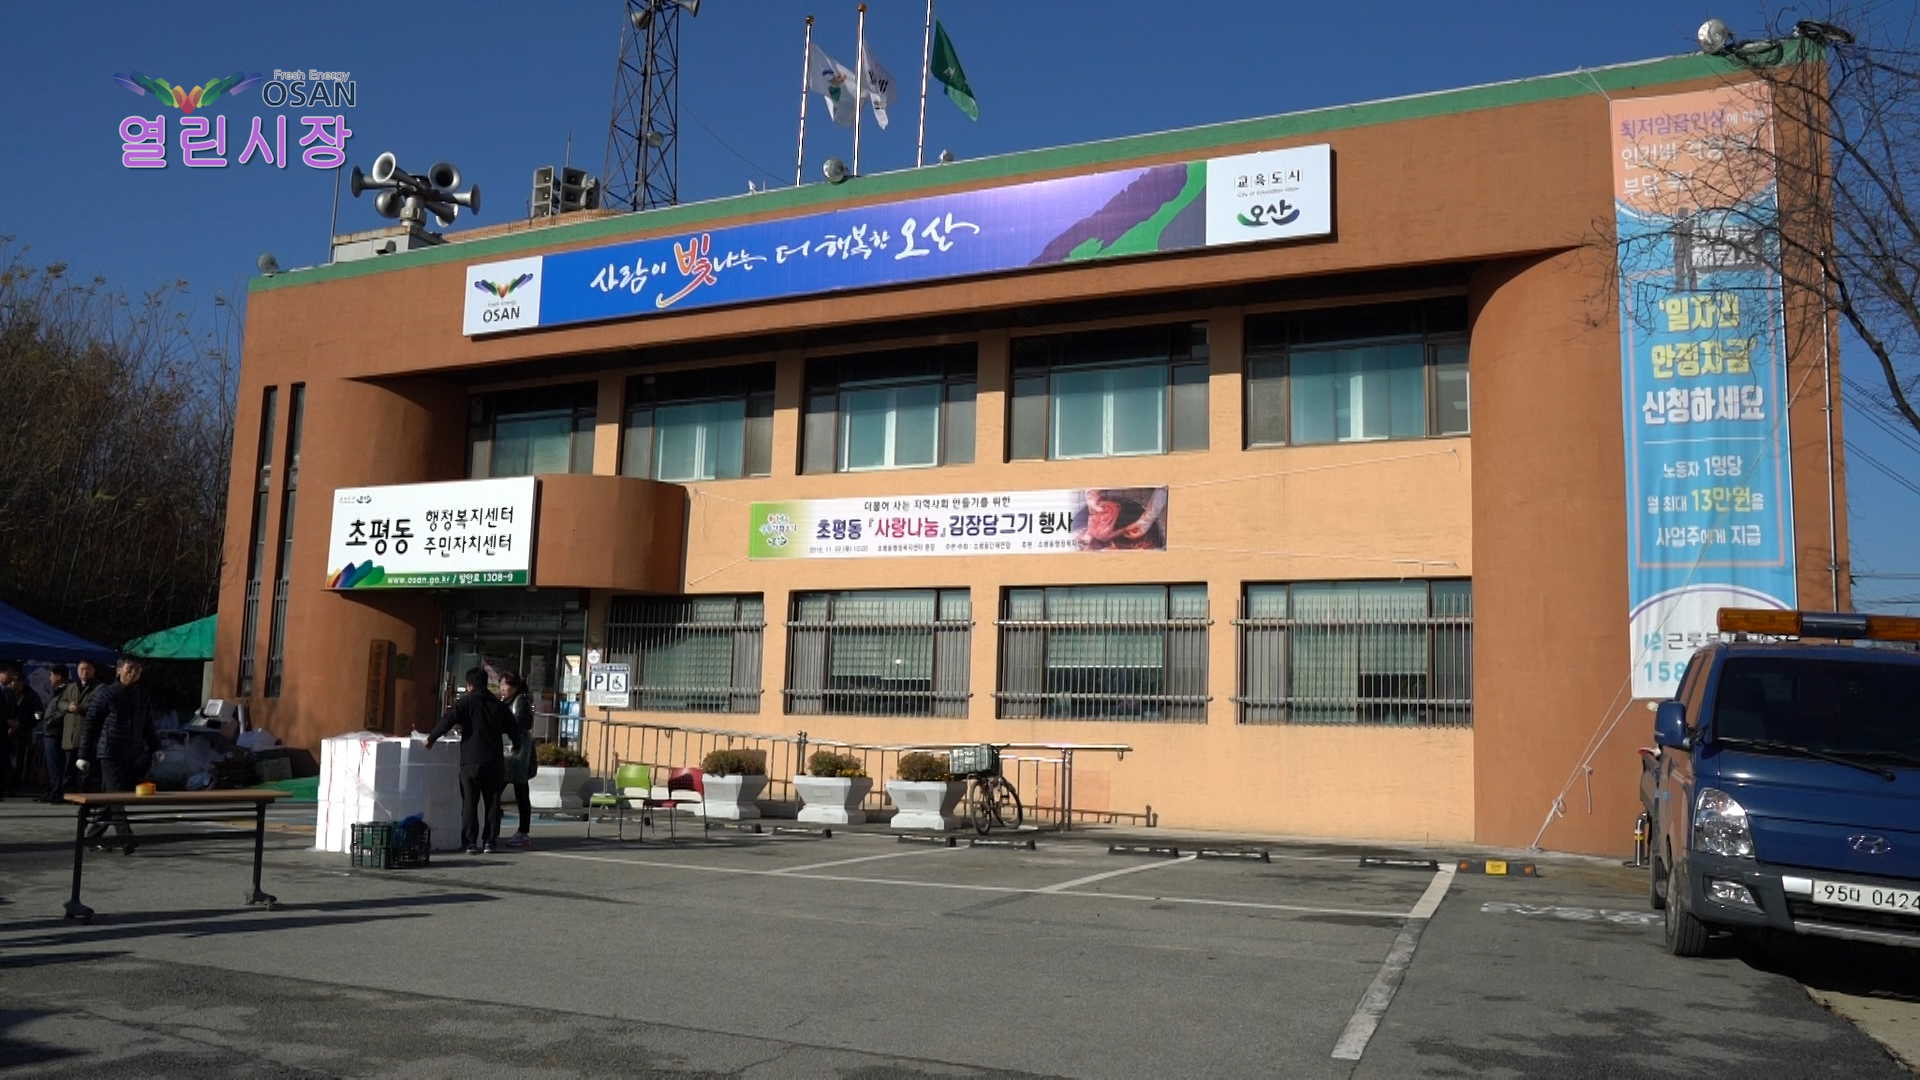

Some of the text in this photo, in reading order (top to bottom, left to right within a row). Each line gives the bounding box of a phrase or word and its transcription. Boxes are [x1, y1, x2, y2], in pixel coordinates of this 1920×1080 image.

[1237, 170, 1300, 188] 교육도시
[1237, 199, 1300, 227] 오산
[590, 212, 981, 309] 사람이 빛나는 더 행복한 오산
[482, 305, 520, 324] OSAN
[1642, 385, 1766, 425] 신청하세요
[1663, 455, 1743, 479] 노동자 1명당
[864, 495, 1011, 512] 더불어 사는 지역사회 만들기를 위한
[1647, 495, 1660, 514] 월
[1662, 495, 1687, 513] 최대
[345, 505, 514, 556] 초평동 행정복지센터
[816, 518, 863, 541] 초평동
[949, 512, 1034, 537] 김장담그기
[1038, 511, 1074, 534] 행사
[1656, 524, 1762, 548] 사업주에게 지급
[423, 533, 512, 558] 주민자치센터
[387, 575, 450, 586] www.osan.go.kr
[483, 571, 514, 583] 1308-9
[594, 674, 604, 690] P
